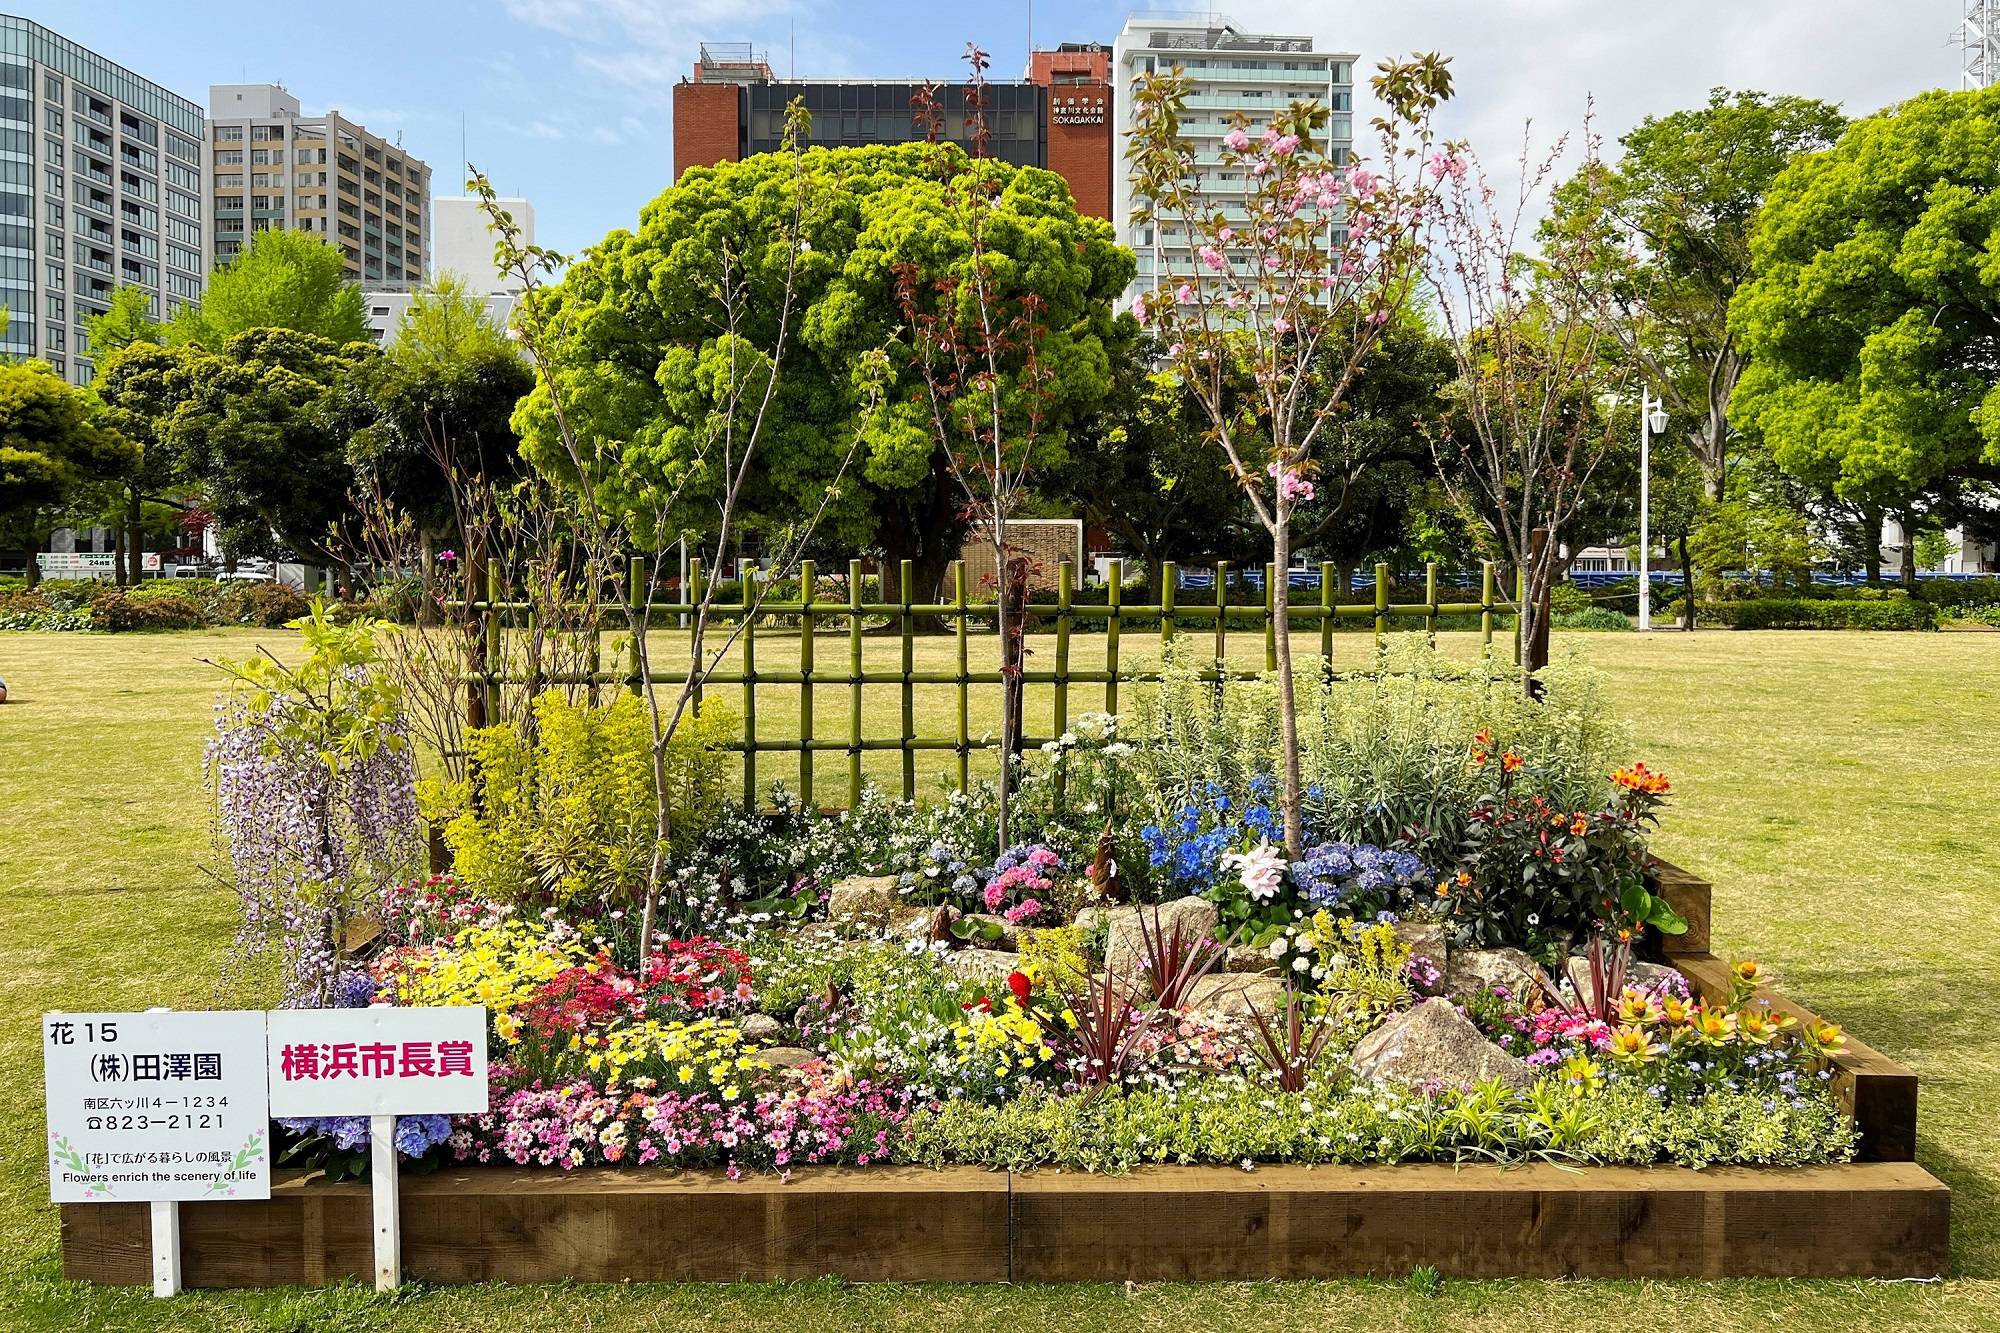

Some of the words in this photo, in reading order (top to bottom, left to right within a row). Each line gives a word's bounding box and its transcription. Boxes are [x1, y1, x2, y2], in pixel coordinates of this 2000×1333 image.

[1053, 97, 1104, 105] 創価学会
[1052, 116, 1104, 124] SOKAGAKKAI
[50, 1021, 75, 1045] 花
[85, 1022, 118, 1043] 15
[90, 1053, 222, 1082] (株)田澤園
[281, 1040, 475, 1081] 横浜市長賞
[85, 1151, 233, 1165] 「花」で広がる暮らしの風景
[62, 1172, 109, 1183] Flowers
[112, 1172, 149, 1182] enrich
[152, 1172, 170, 1182] the
[174, 1172, 220, 1183] scenery
[223, 1170, 236, 1181] of
[239, 1170, 257, 1180] life
